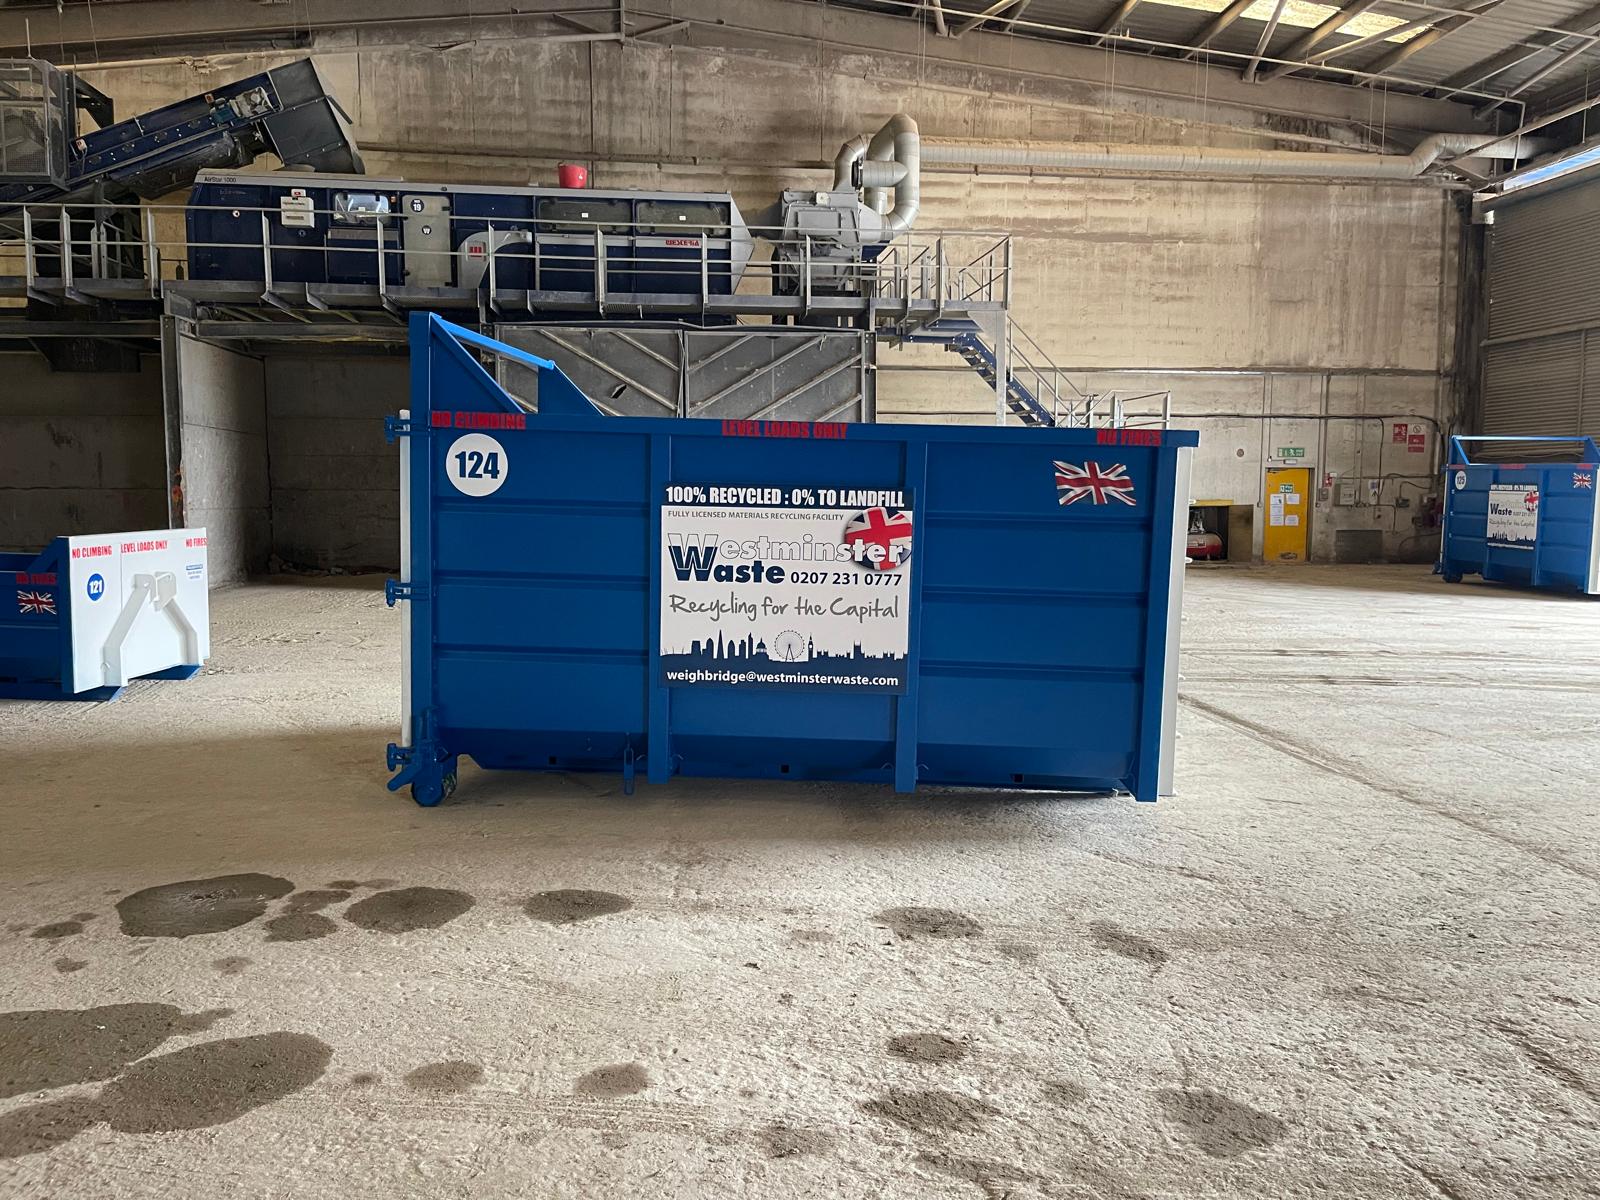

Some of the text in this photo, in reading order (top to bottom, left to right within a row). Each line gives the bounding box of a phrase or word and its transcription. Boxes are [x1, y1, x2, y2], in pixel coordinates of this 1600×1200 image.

[413, 203, 421, 212] 19
[432, 411, 526, 430] NO CLIMBING
[722, 420, 848, 439] LEVEL LOADS ONLY
[1097, 429, 1161, 447] NO FIRES
[455, 451, 500, 479] 124
[1457, 475, 1465, 485] 125
[666, 486, 706, 503] 100%
[709, 487, 782, 505] RECYCLED
[791, 489, 814, 506] 0%
[817, 489, 837, 506] TO
[840, 490, 905, 507] LANDFILL
[668, 510, 844, 521] FULLY LICENSED MATERIALS RECYCLING FACILITY
[1490, 502, 1512, 516] Waste
[121, 540, 168, 553] LEVEL LOADS ONLY
[193, 538, 207, 547] FIRES
[72, 545, 112, 558] NO CLIMBING
[667, 532, 904, 570] Westminster
[667, 545, 785, 584] Waste
[790, 571, 902, 586] 0207 231 0777
[89, 580, 103, 594] 121
[668, 591, 899, 624] Recycling for the Capital
[666, 670, 899, 686] weighbridge@westminsterwaste.com
